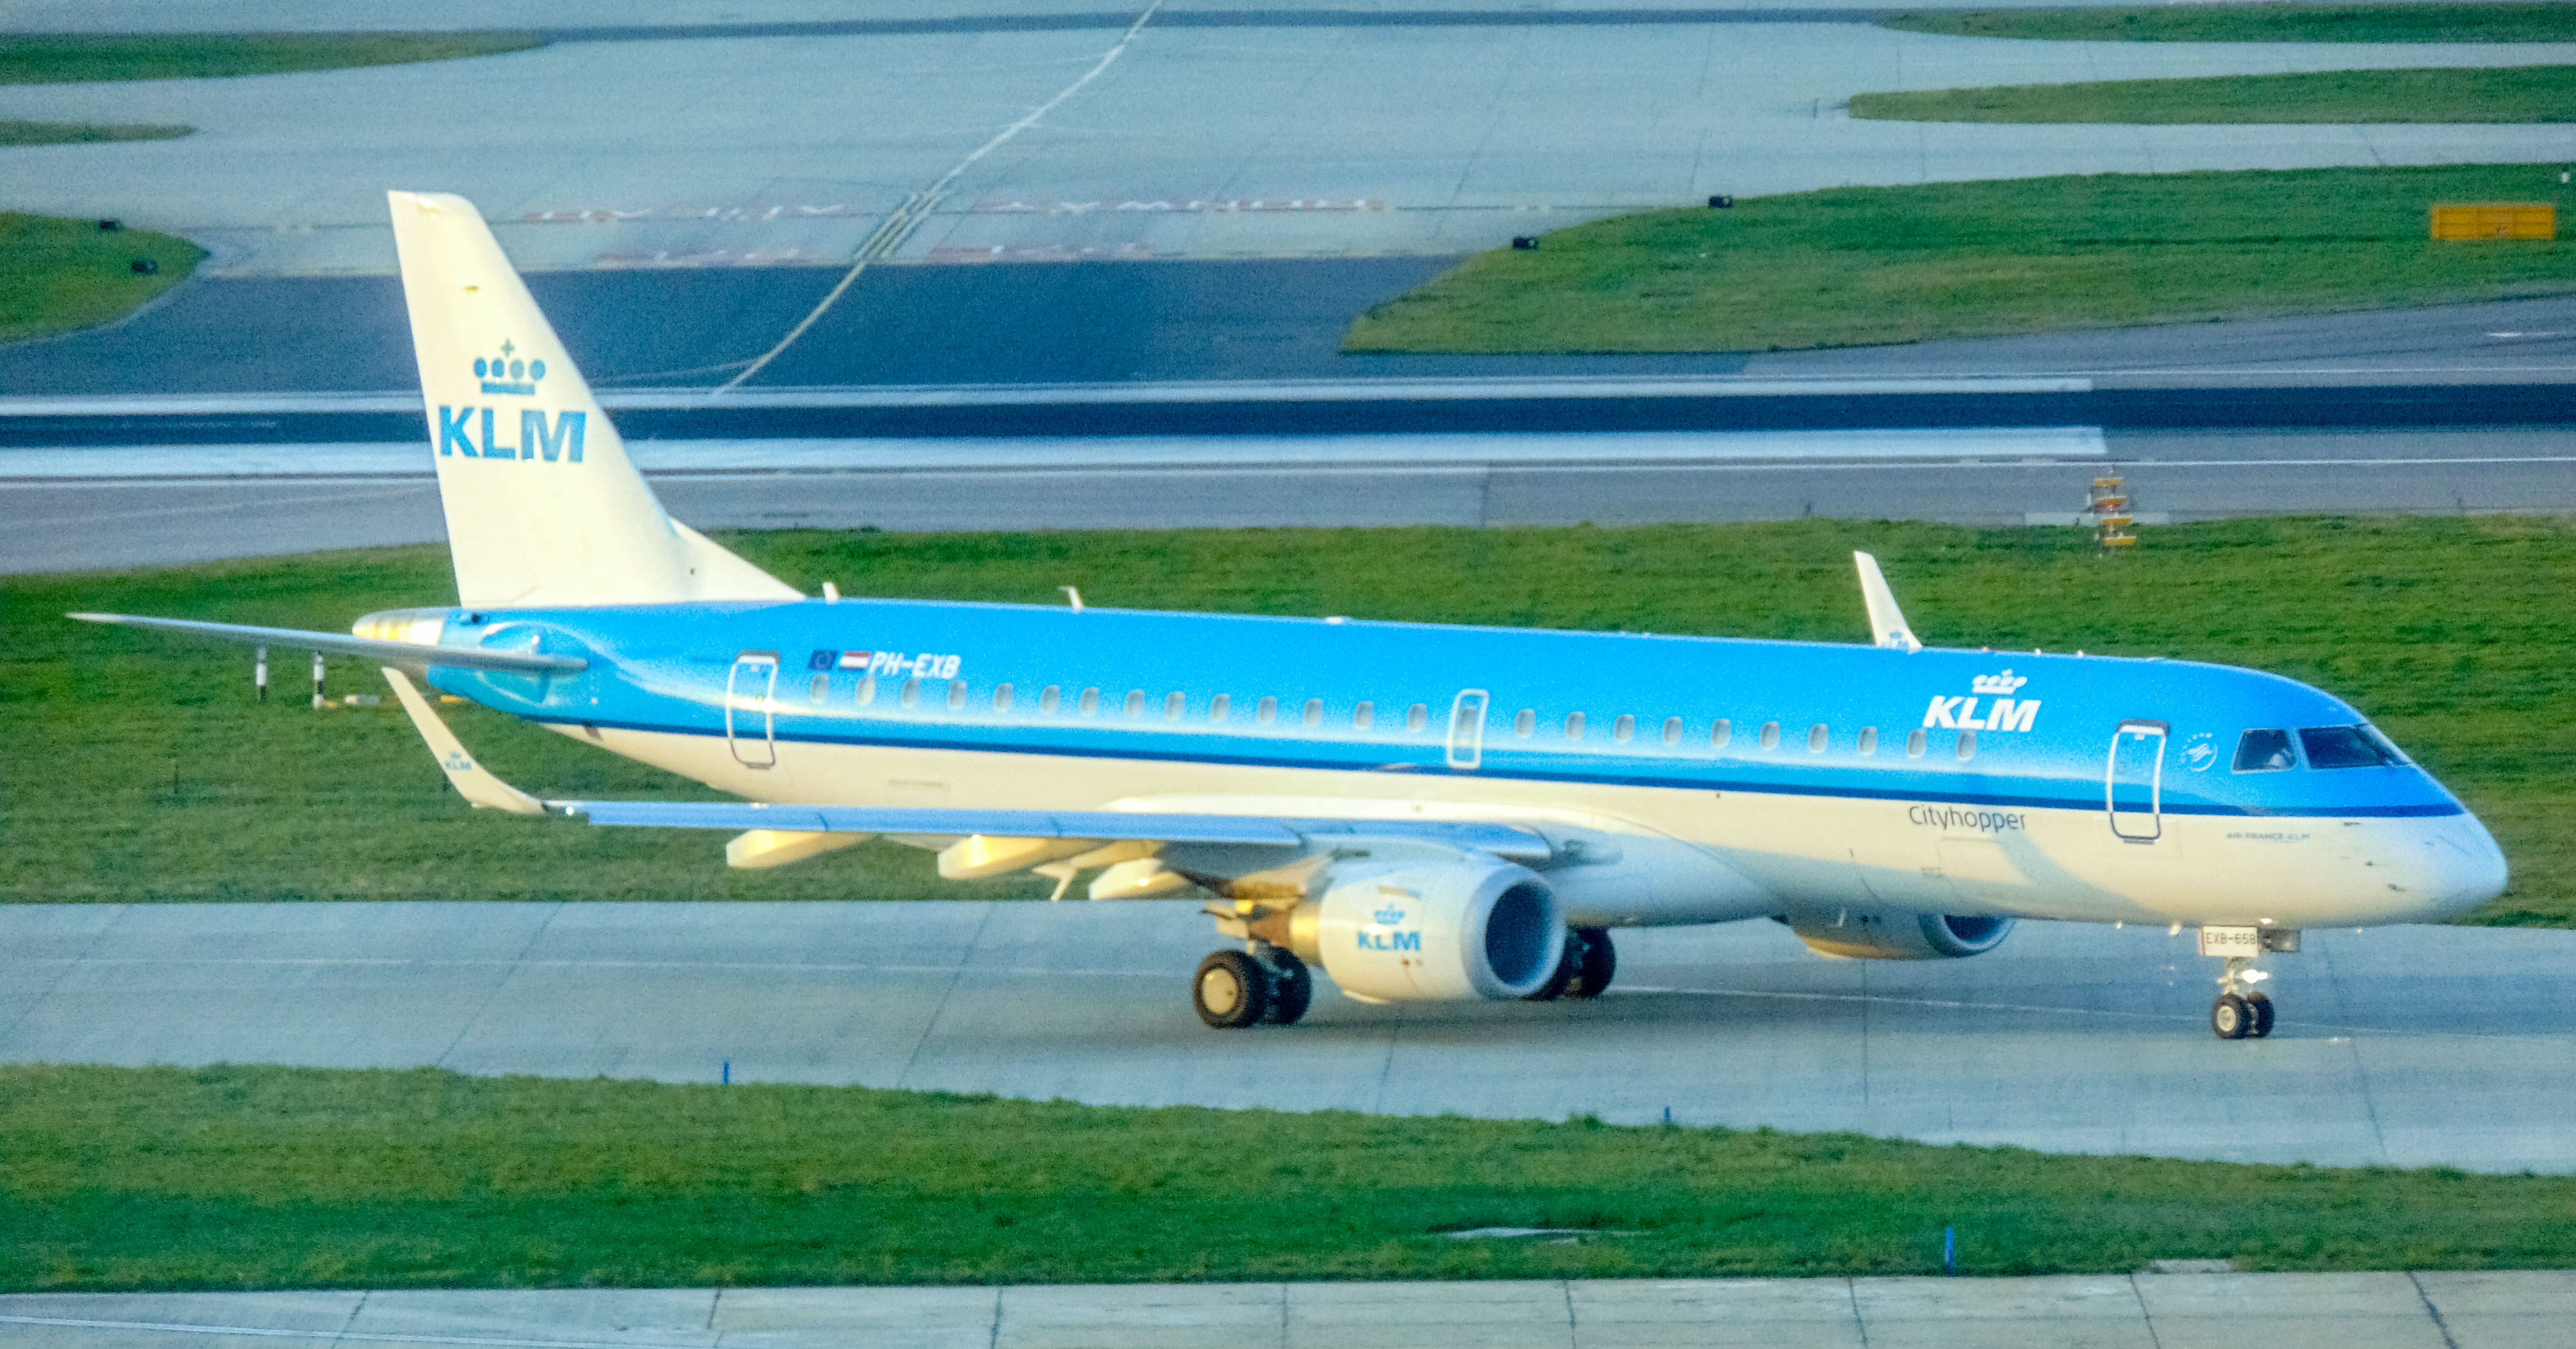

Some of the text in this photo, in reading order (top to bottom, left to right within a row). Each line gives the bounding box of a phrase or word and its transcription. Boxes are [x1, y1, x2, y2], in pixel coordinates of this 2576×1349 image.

[439, 405, 586, 463] KLM
[868, 650, 962, 679] PH-EXB
[1922, 695, 2041, 732] KLM
[1909, 805, 2026, 832] Cityhopper
[1357, 931, 1422, 951] KLM
